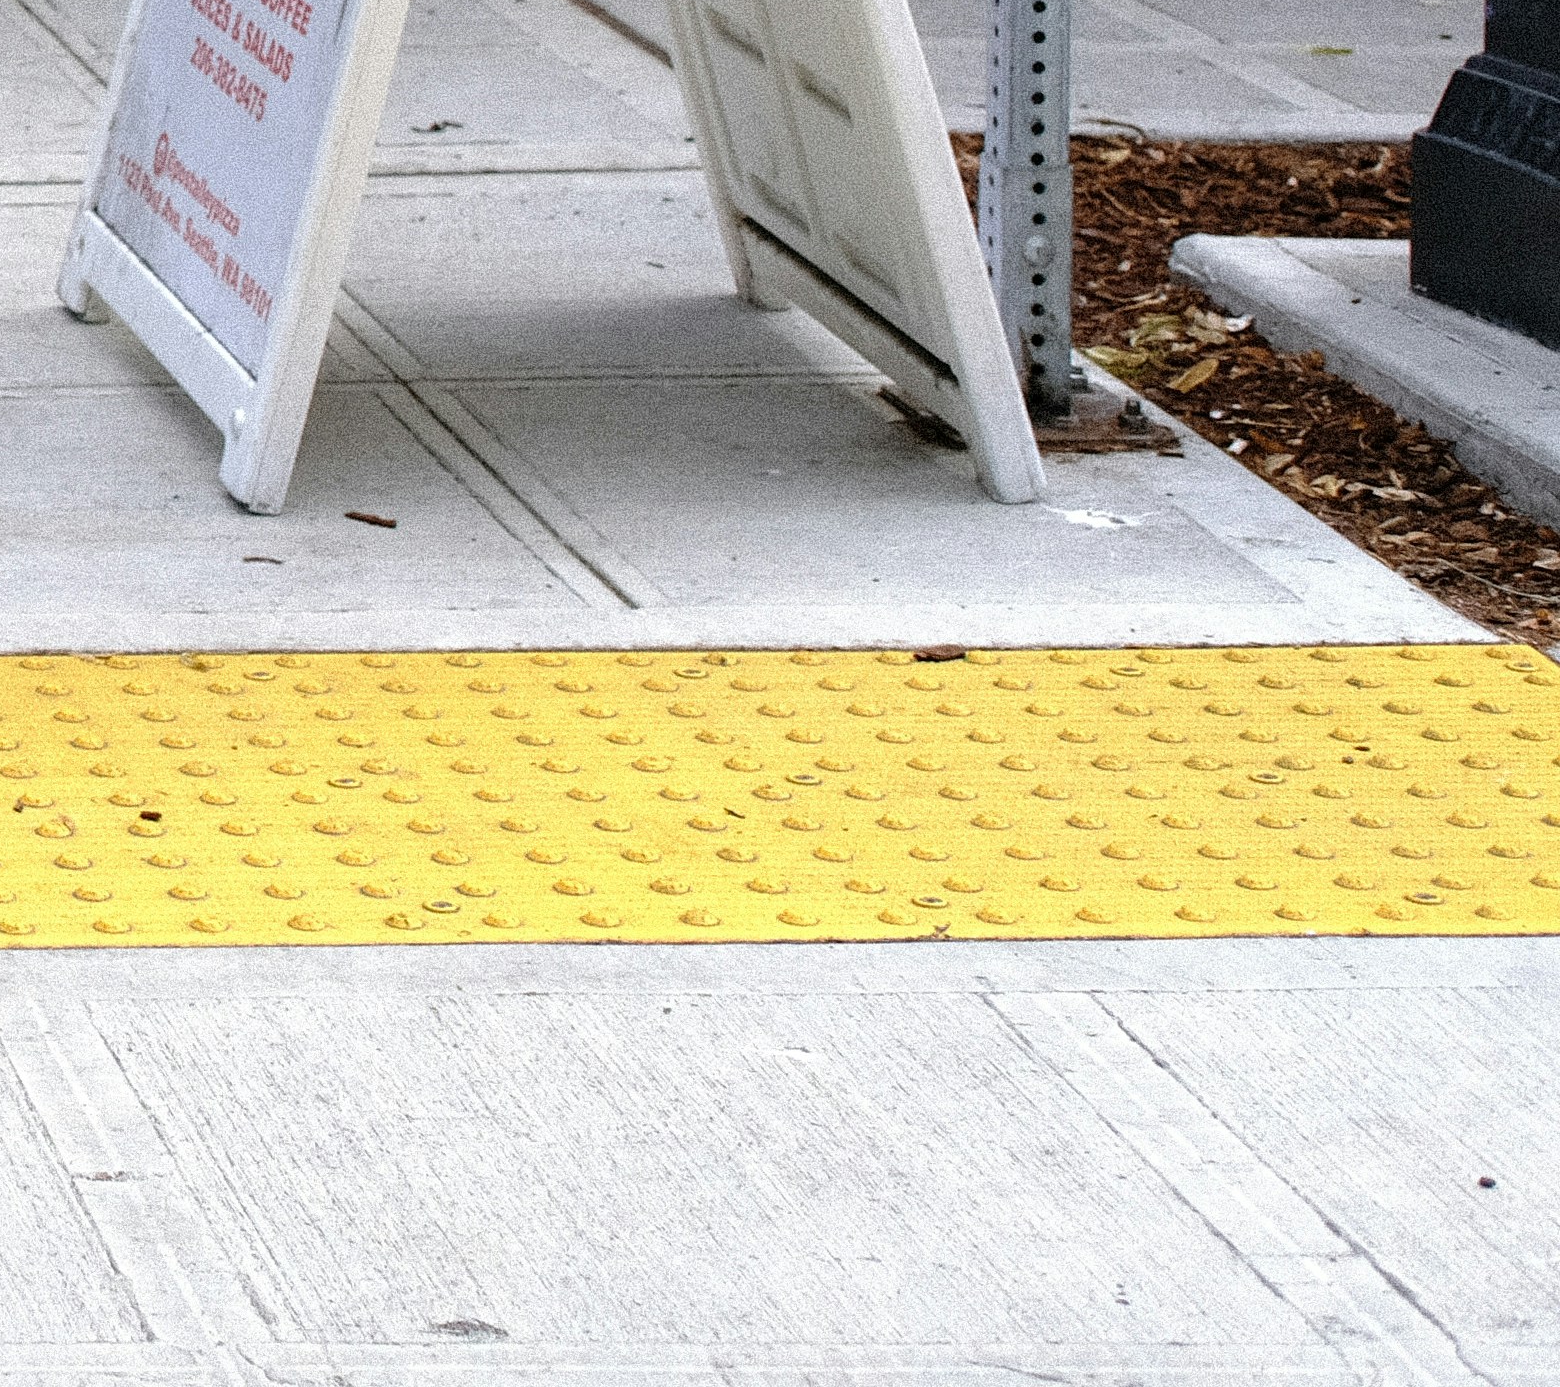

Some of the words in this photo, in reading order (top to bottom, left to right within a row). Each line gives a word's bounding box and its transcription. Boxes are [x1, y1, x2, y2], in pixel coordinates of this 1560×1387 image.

[231, 11, 244, 43] &
[243, 19, 295, 84] SALADS
[139, 173, 163, 215] Post
[221, 252, 241, 293] WA
